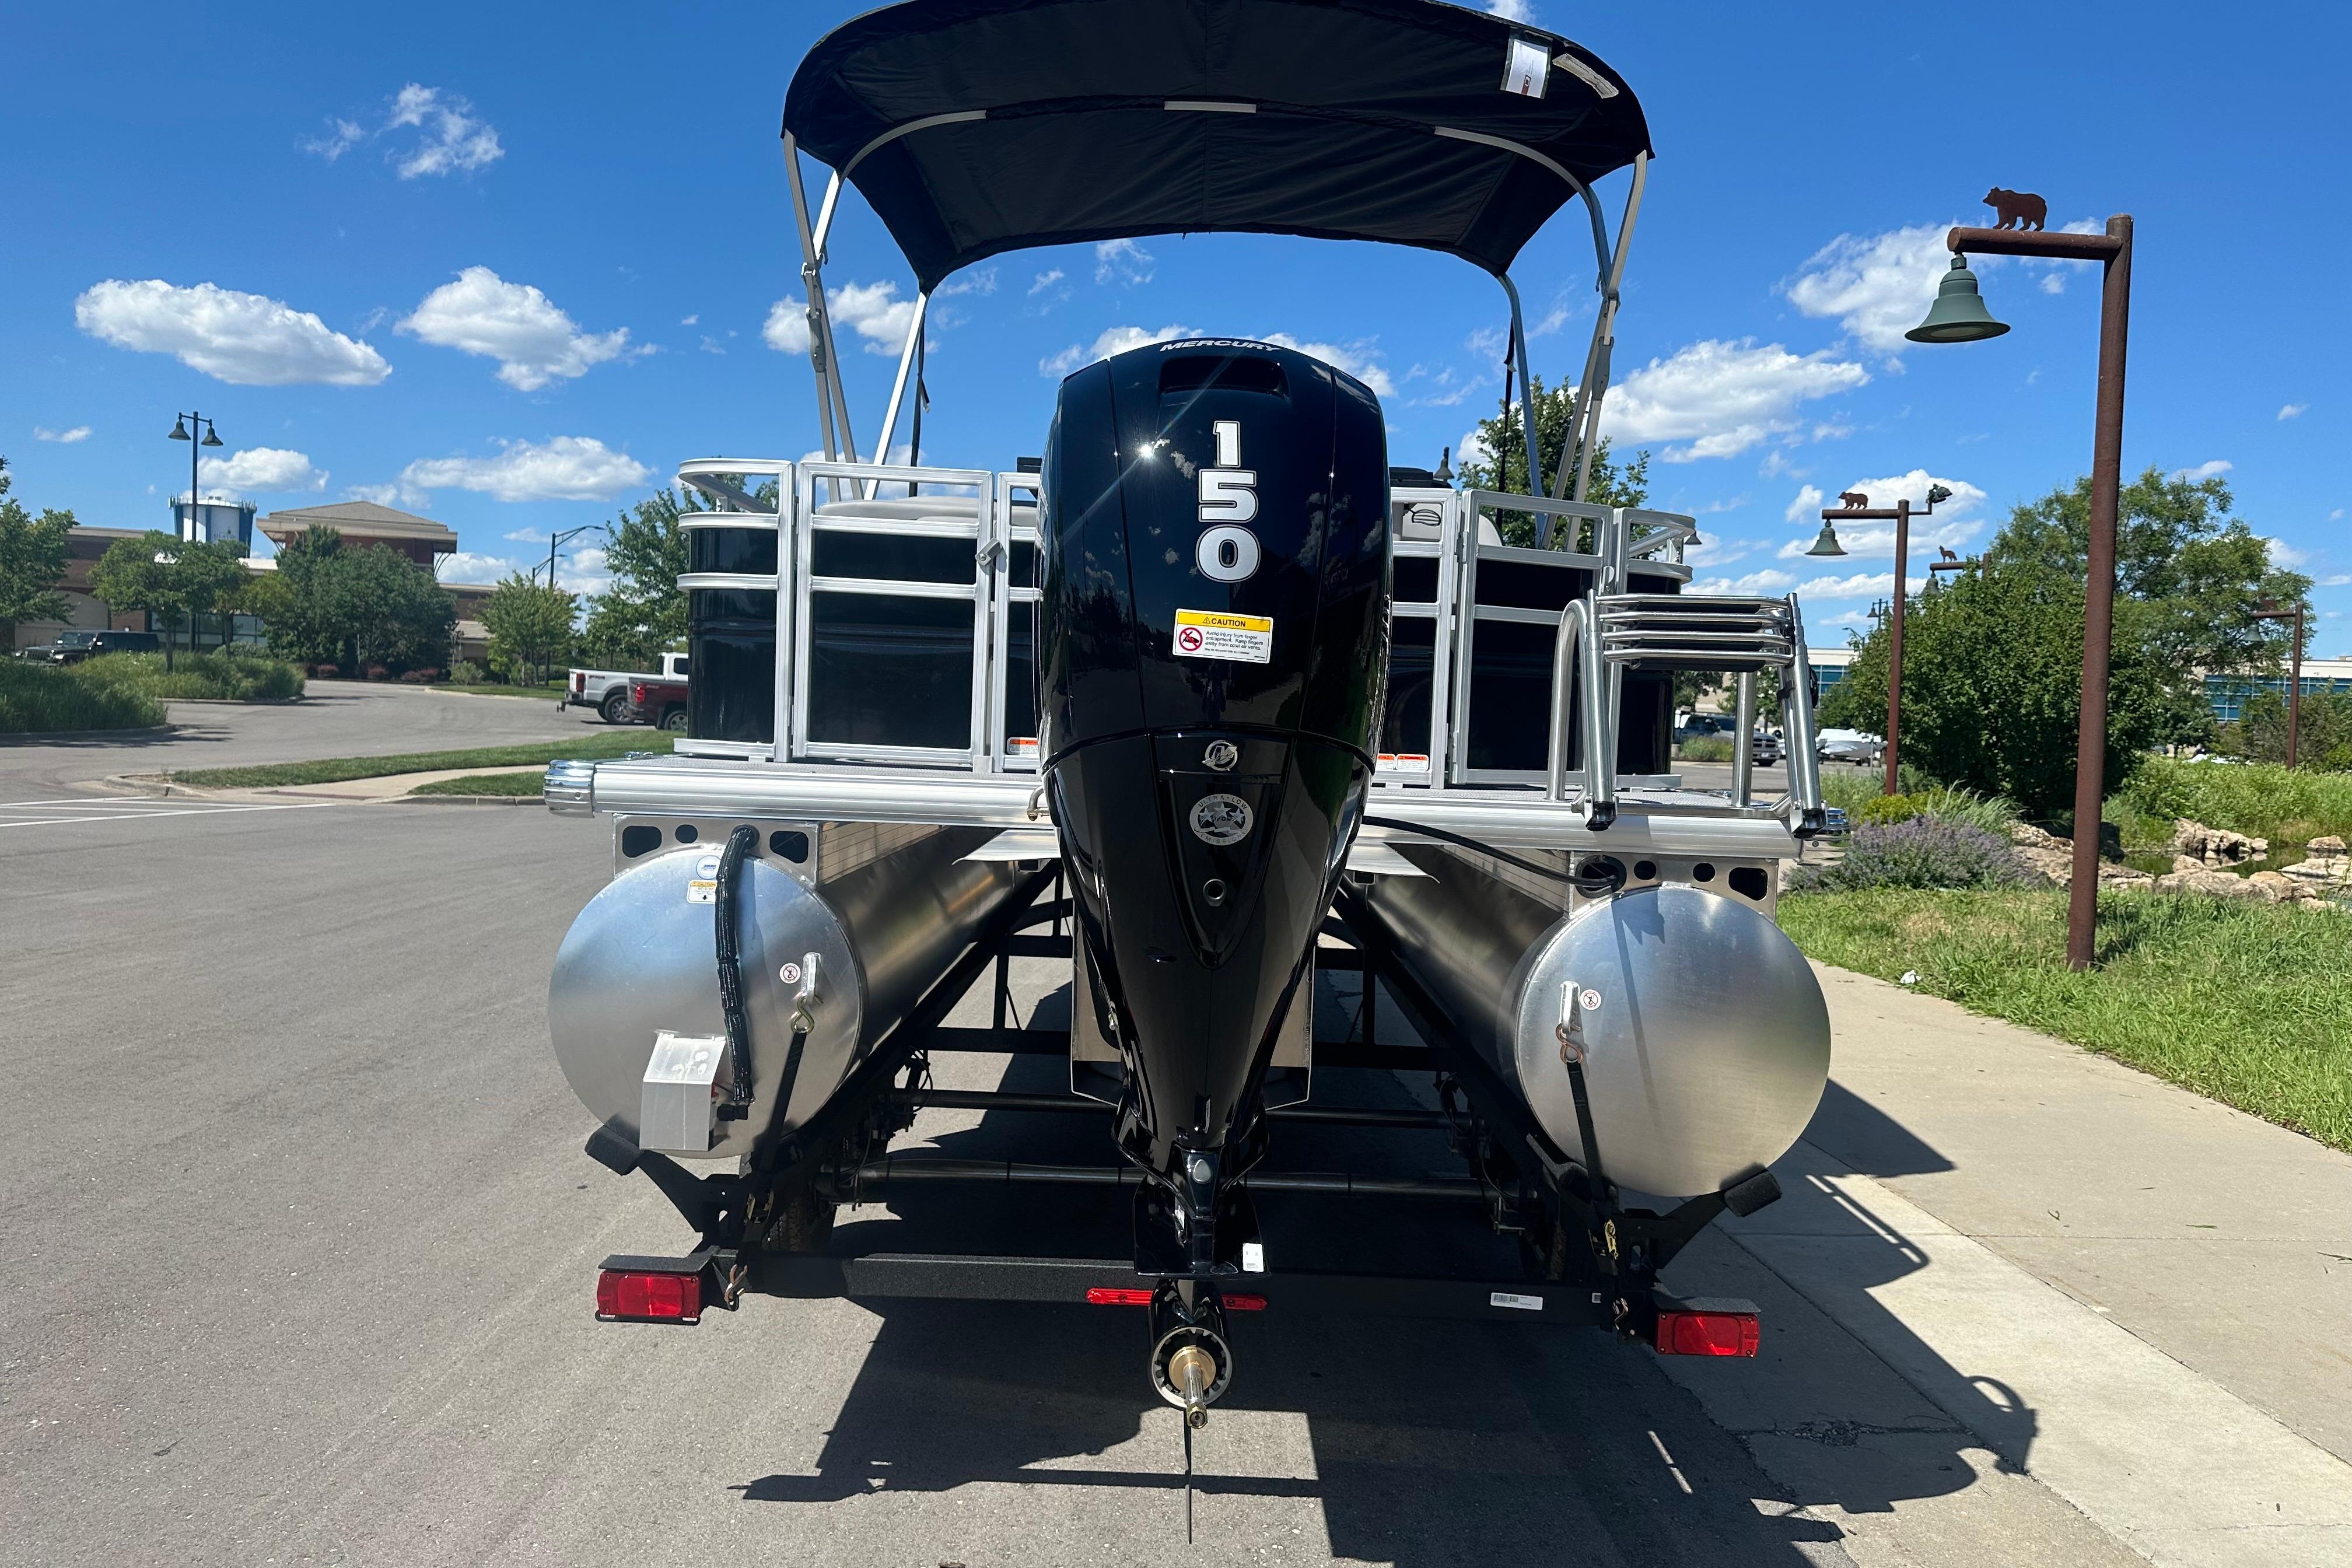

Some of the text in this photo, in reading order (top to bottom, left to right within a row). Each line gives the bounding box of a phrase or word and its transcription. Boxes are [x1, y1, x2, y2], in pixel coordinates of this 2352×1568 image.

[1160, 340, 1281, 352] MERCURY
[1195, 421, 1261, 583] 150
[1211, 618, 1246, 627] CAUTION
